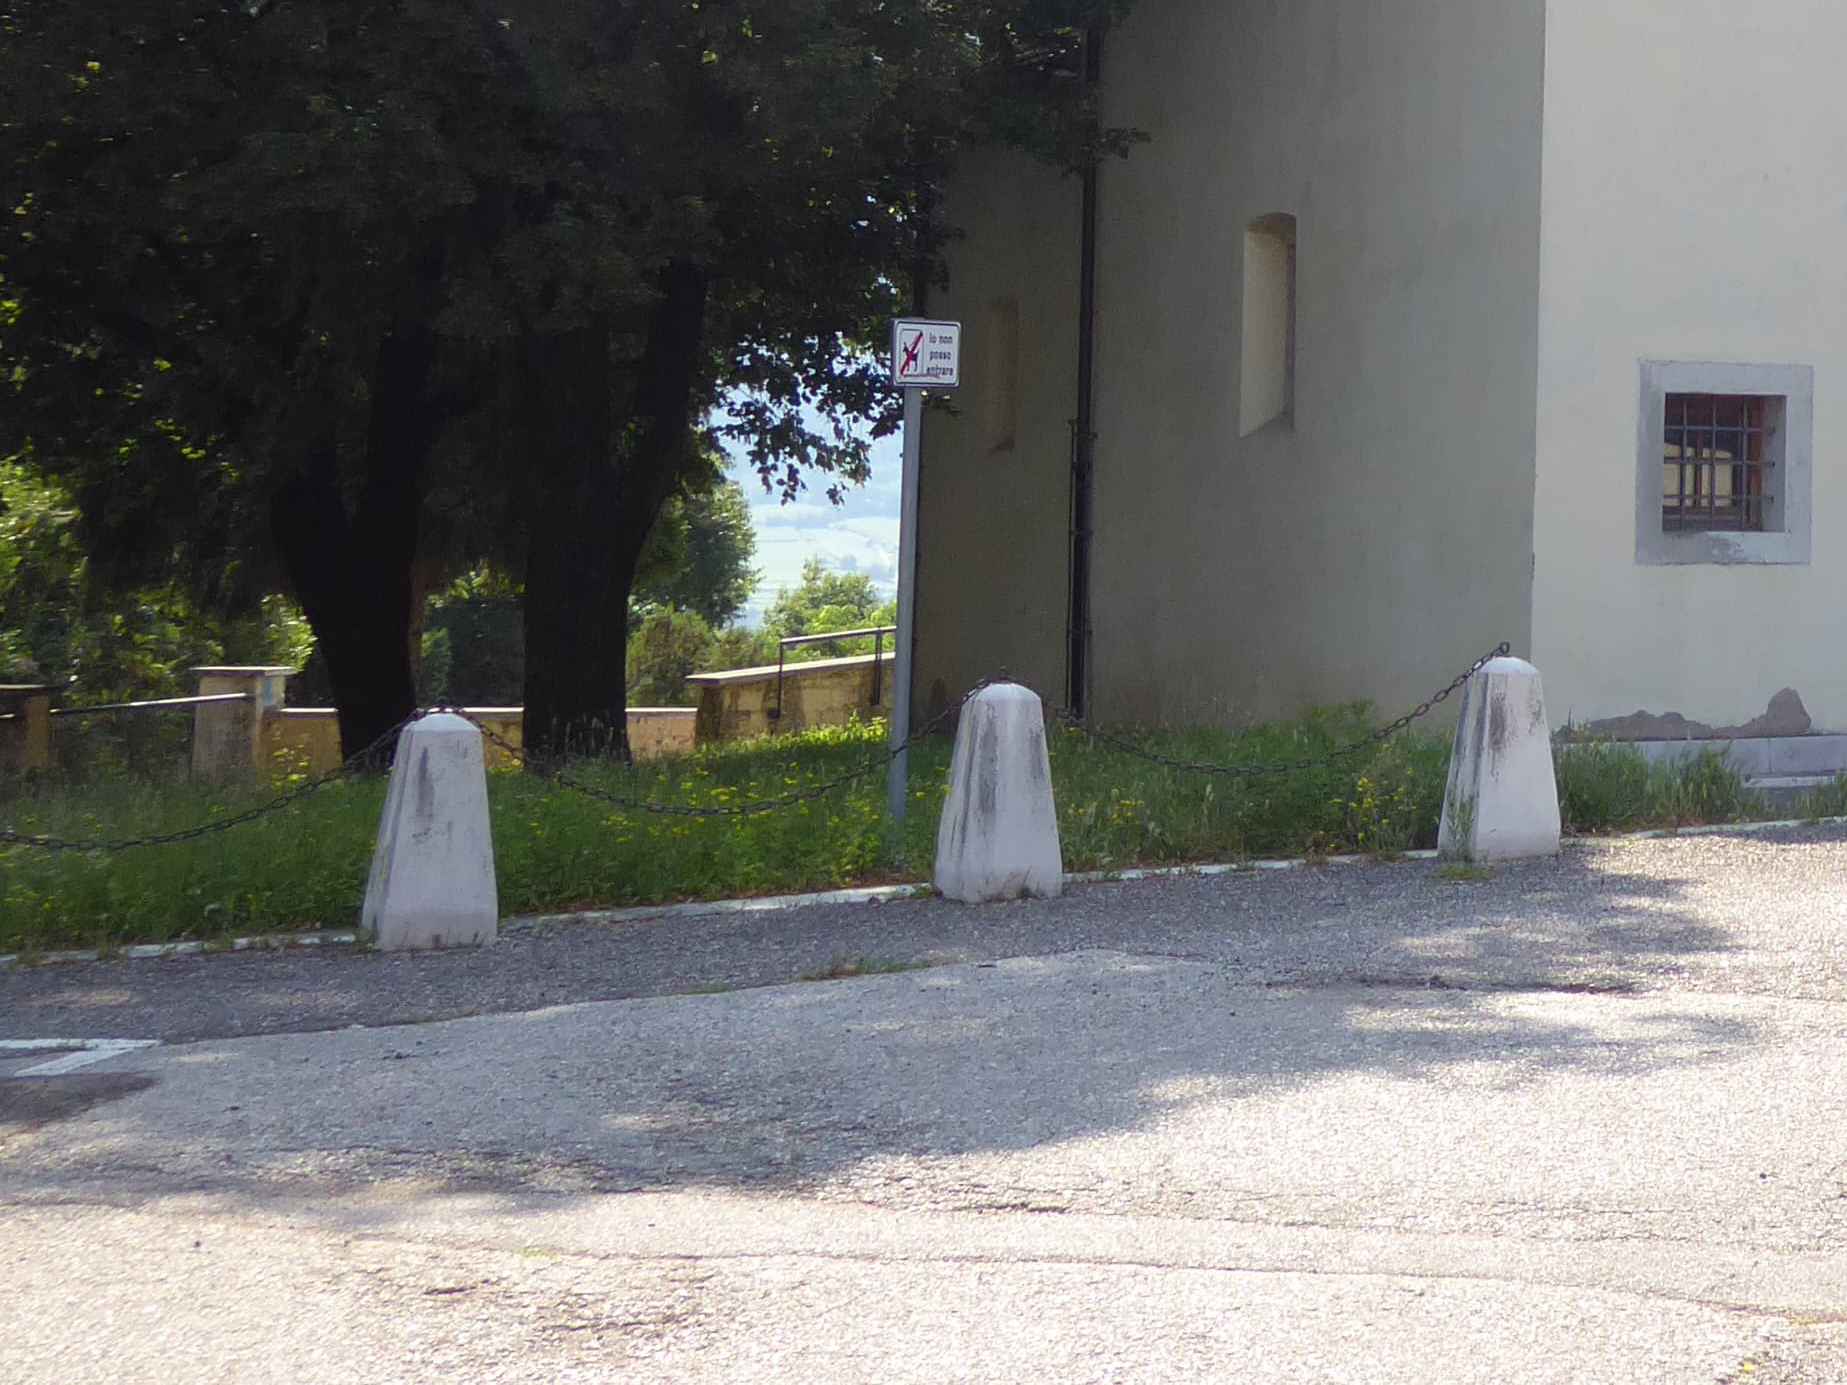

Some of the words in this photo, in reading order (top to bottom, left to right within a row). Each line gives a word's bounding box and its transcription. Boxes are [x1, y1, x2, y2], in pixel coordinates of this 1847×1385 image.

[939, 335, 953, 344] non
[929, 350, 952, 361] posso
[926, 364, 954, 375] entrare
